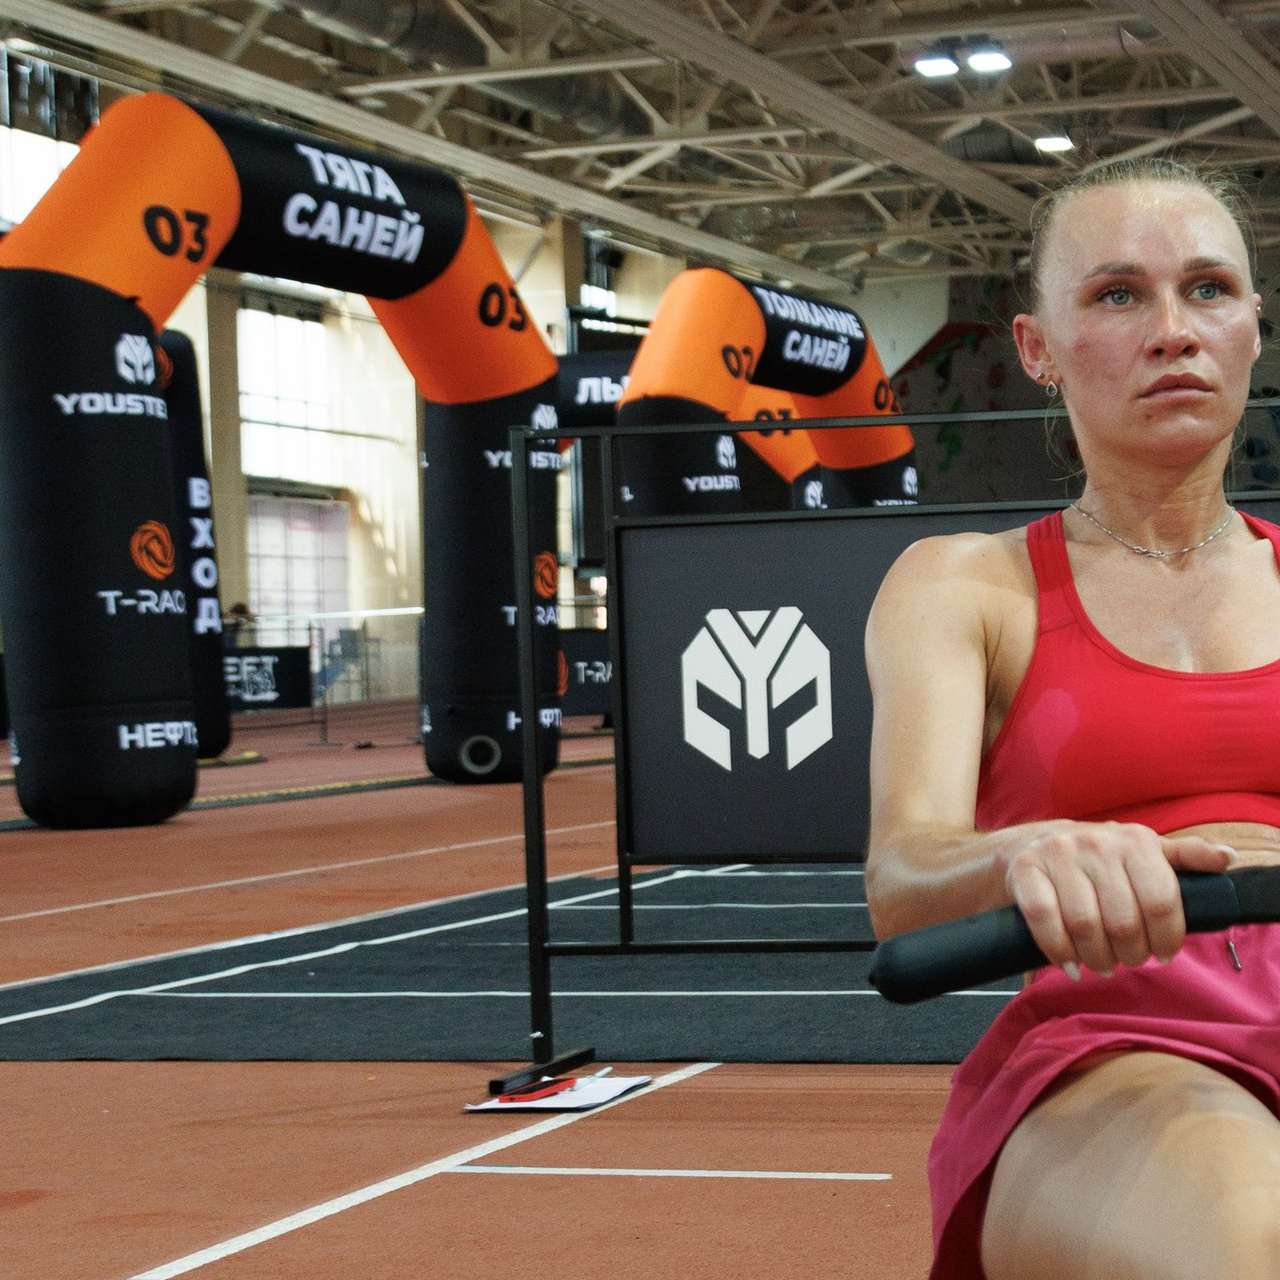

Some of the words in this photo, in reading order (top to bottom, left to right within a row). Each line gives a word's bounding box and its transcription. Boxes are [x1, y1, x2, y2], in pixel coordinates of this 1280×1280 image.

[294, 143, 407, 205] ТЯГА
[143, 205, 210, 263] 03
[283, 192, 425, 264] САНЕЙ
[783, 330, 851, 373] САНЕЙ
